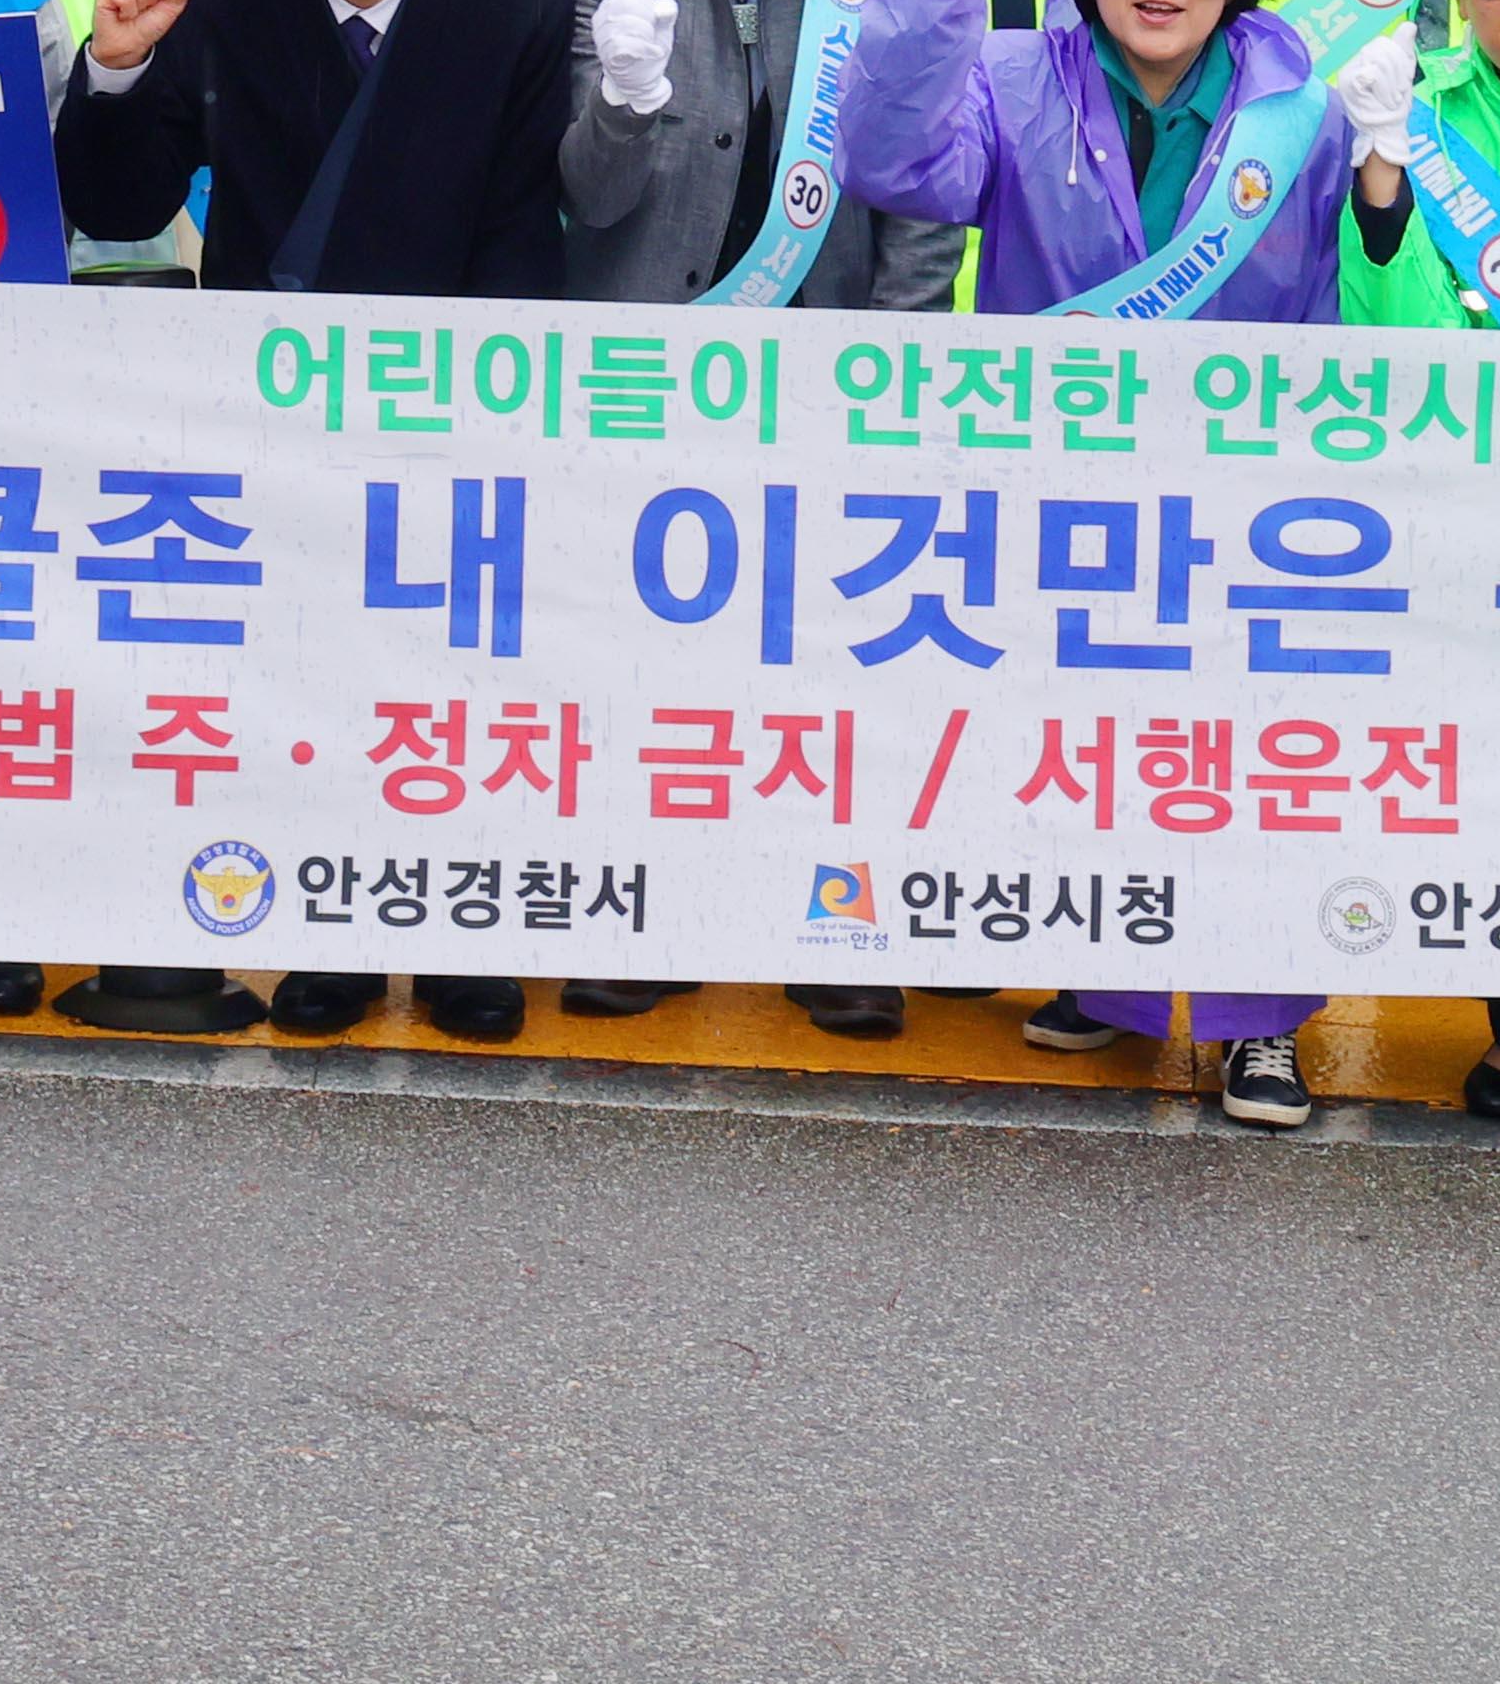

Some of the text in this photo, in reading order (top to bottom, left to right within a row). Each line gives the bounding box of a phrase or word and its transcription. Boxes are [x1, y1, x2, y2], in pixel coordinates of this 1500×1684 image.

[789, 175, 823, 216] 30
[258, 327, 779, 445] 어린이들이
[836, 344, 1146, 453] 안전한
[365, 478, 526, 658] 내
[634, 486, 1410, 675] 이것만은
[133, 696, 239, 807] 주
[369, 701, 592, 818] 정차
[640, 710, 854, 825] 금지
[910, 711, 969, 830] /
[1017, 718, 1459, 834] 서행운전
[215, 898, 272, 934] POLICE STATION
[299, 858, 647, 933] 안성경찰서
[903, 873, 1175, 945] 안성시청
[850, 931, 890, 952] 안성
